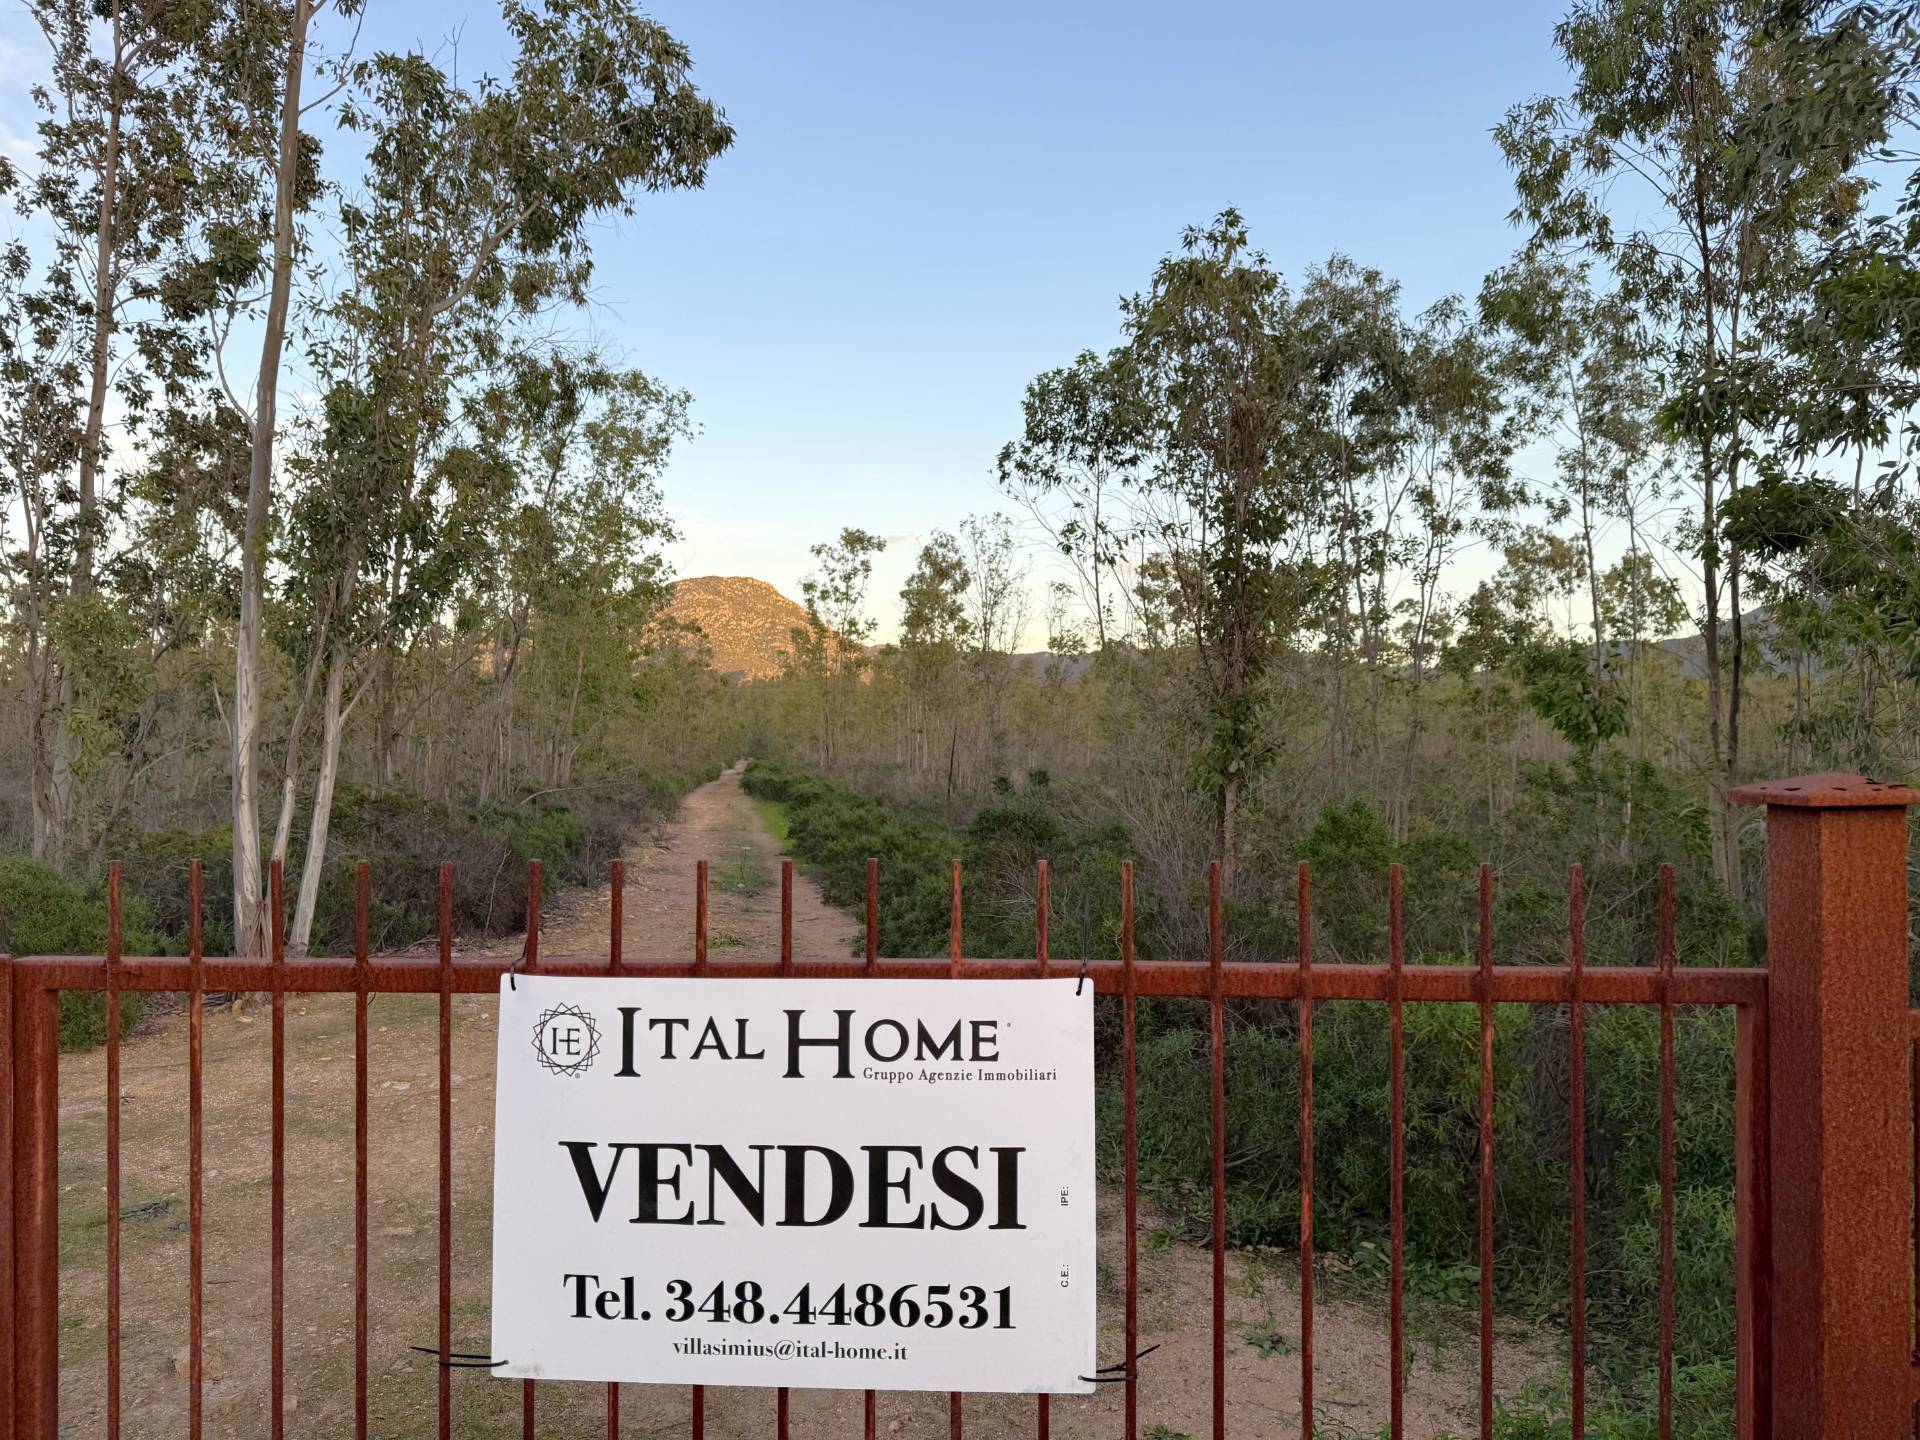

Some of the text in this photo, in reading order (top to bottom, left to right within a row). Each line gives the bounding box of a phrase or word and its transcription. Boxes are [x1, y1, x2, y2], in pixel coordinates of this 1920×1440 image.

[862, 1066, 1057, 1085] Gruppo Agenzie Immobiliari
[557, 1140, 1028, 1232] VENDESI
[1060, 1185, 1070, 1207] IPE:
[562, 1273, 1017, 1330] Tel. 348.4486531
[671, 1337, 909, 1361] villasimius@ital-home.it
